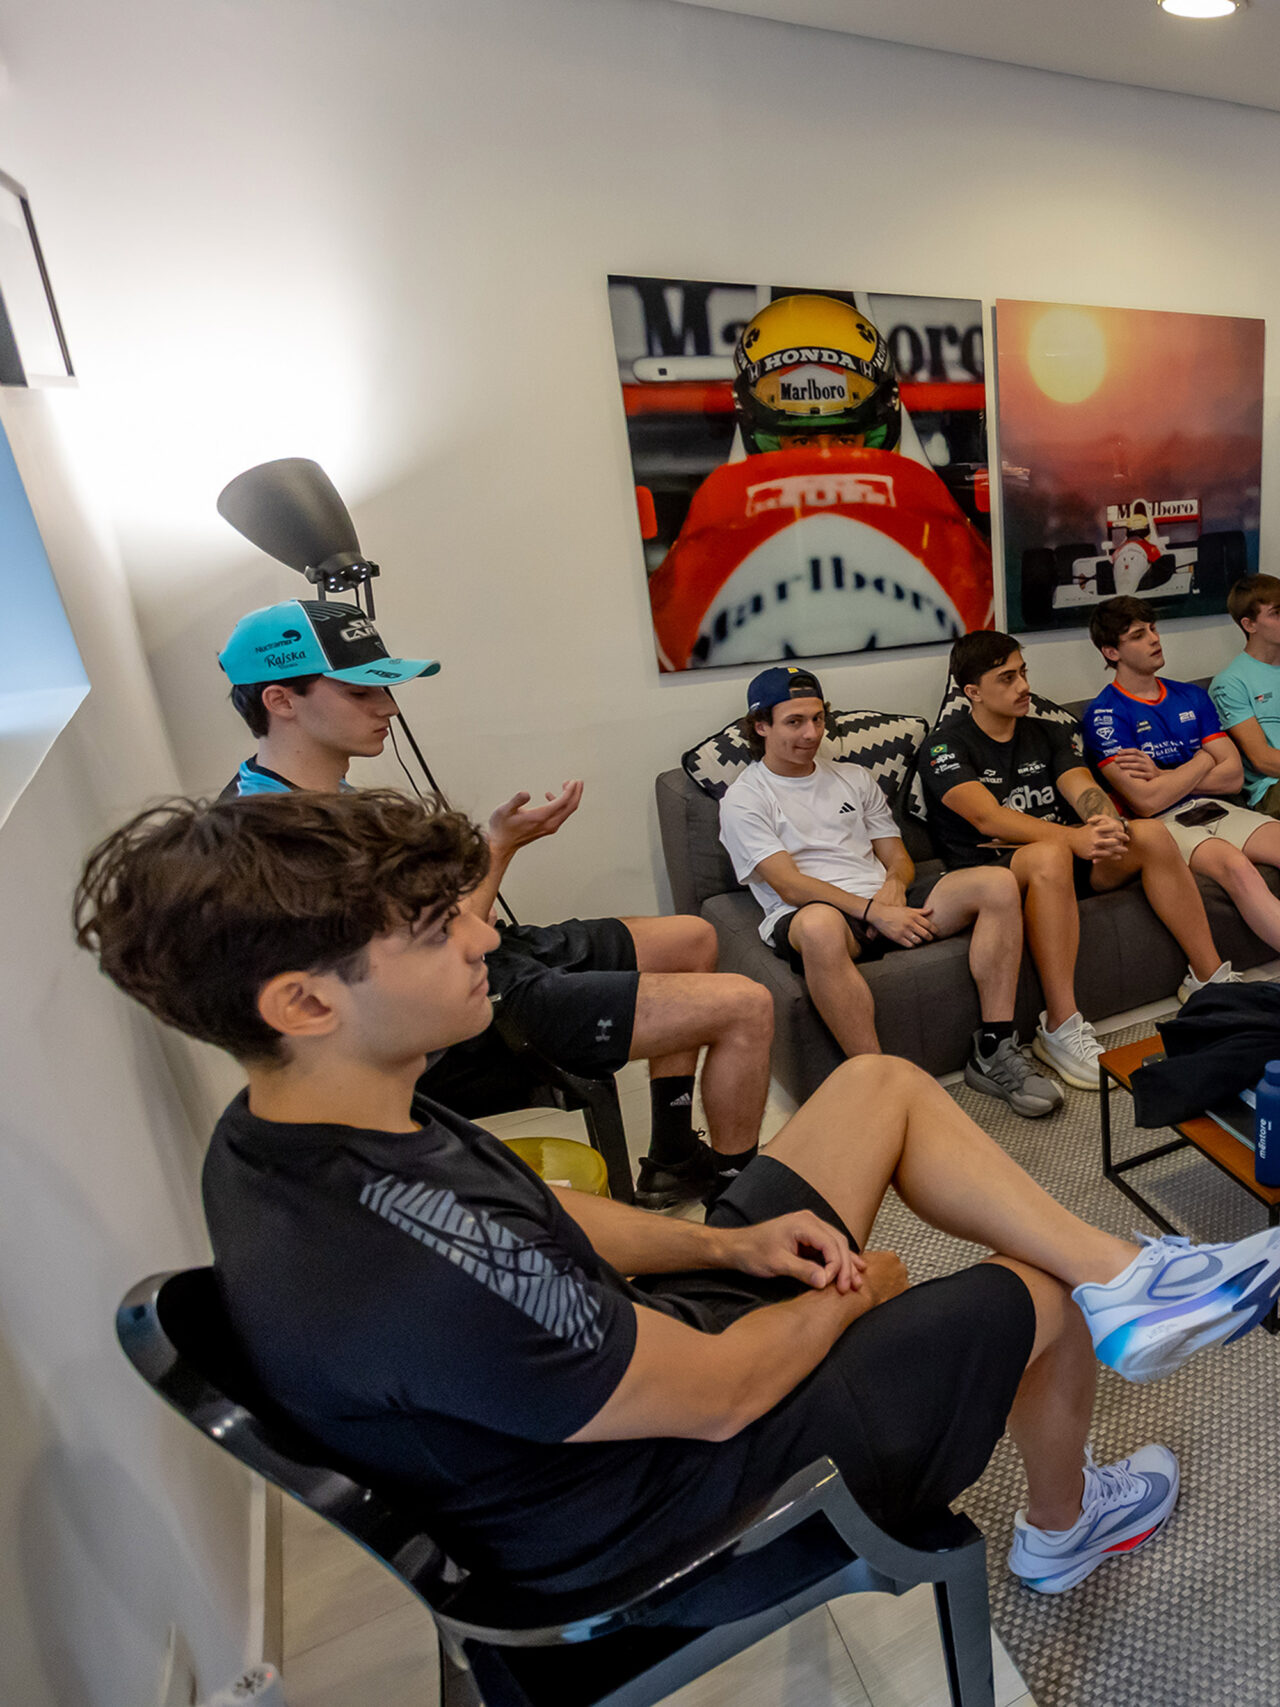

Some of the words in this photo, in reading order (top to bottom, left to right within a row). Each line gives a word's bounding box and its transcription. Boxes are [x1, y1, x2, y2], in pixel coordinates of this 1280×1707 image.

[764, 348, 857, 371] HONDA
[780, 378, 845, 401] Marlboro
[1117, 500, 1194, 519] Mlboro
